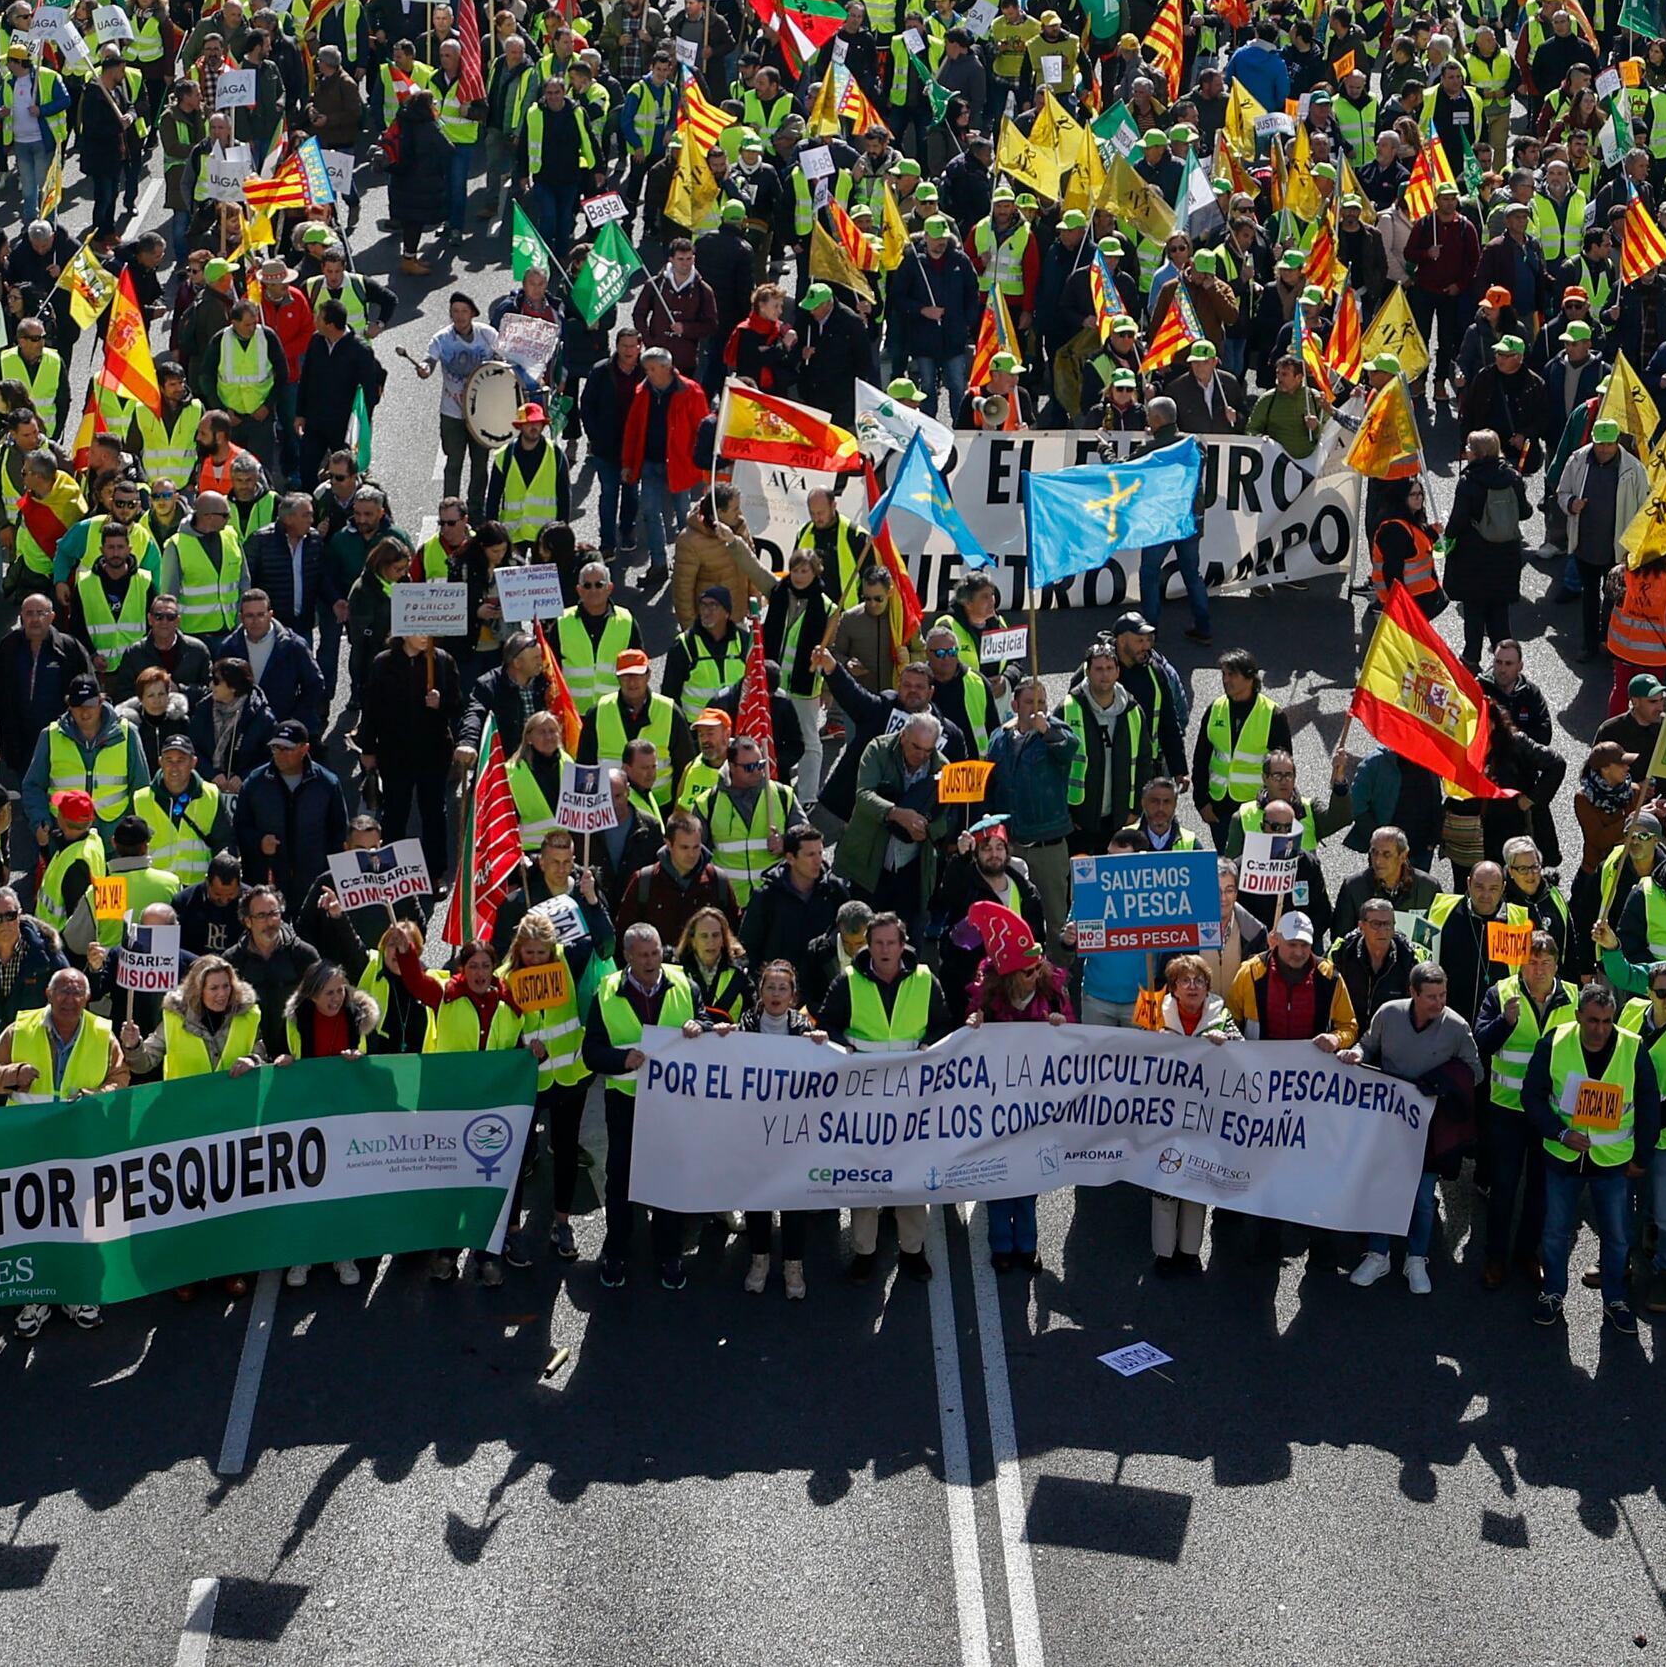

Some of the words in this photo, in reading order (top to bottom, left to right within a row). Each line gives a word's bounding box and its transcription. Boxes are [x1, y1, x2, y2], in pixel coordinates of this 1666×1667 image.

[97, 17, 125, 30] UAGA
[586, 194, 624, 221] Basta!
[983, 632, 1024, 654] ¡Justicia!
[343, 876, 429, 908] ¡DIMISIÓN!
[1101, 867, 1190, 891] SALVEMOS
[1104, 895, 1118, 919] A
[1125, 891, 1193, 918] PESCA
[1079, 931, 1094, 942] NO
[1110, 934, 1137, 946] SOS
[1142, 931, 1189, 944] PESCA
[1492, 932, 1527, 958] ¡JUSTICIA
[648, 1059, 696, 1096] POR
[705, 1064, 732, 1100] EL
[741, 1067, 838, 1102] FUTURO
[845, 1069, 877, 1096] DE
[882, 1066, 910, 1097] LA
[919, 1055, 997, 1097] PESCA,
[1005, 1054, 1031, 1088] LA
[1040, 1053, 1210, 1098] ACUICULTURA,
[1219, 1069, 1262, 1104] LAS
[1268, 1070, 1420, 1130] PESCADERÍAS
[1605, 1093, 1619, 1120] YA!
[763, 1115, 777, 1145] Y
[783, 1113, 810, 1144] LA
[818, 1111, 896, 1145] SALUD
[903, 1107, 930, 1141] DE
[938, 1103, 982, 1139] LOS
[991, 1096, 1174, 1137] CONSUMIDORES
[1181, 1101, 1213, 1133] EN
[1220, 1109, 1306, 1149] ESPAÑA
[1064, 1149, 1123, 1161] APROMAR
[1188, 1154, 1250, 1180] FEDEPESCA
[93, 1126, 327, 1227] PESQUERO
[808, 1166, 893, 1185] cepesca
[8, 1286, 57, 1299] Pesquero
